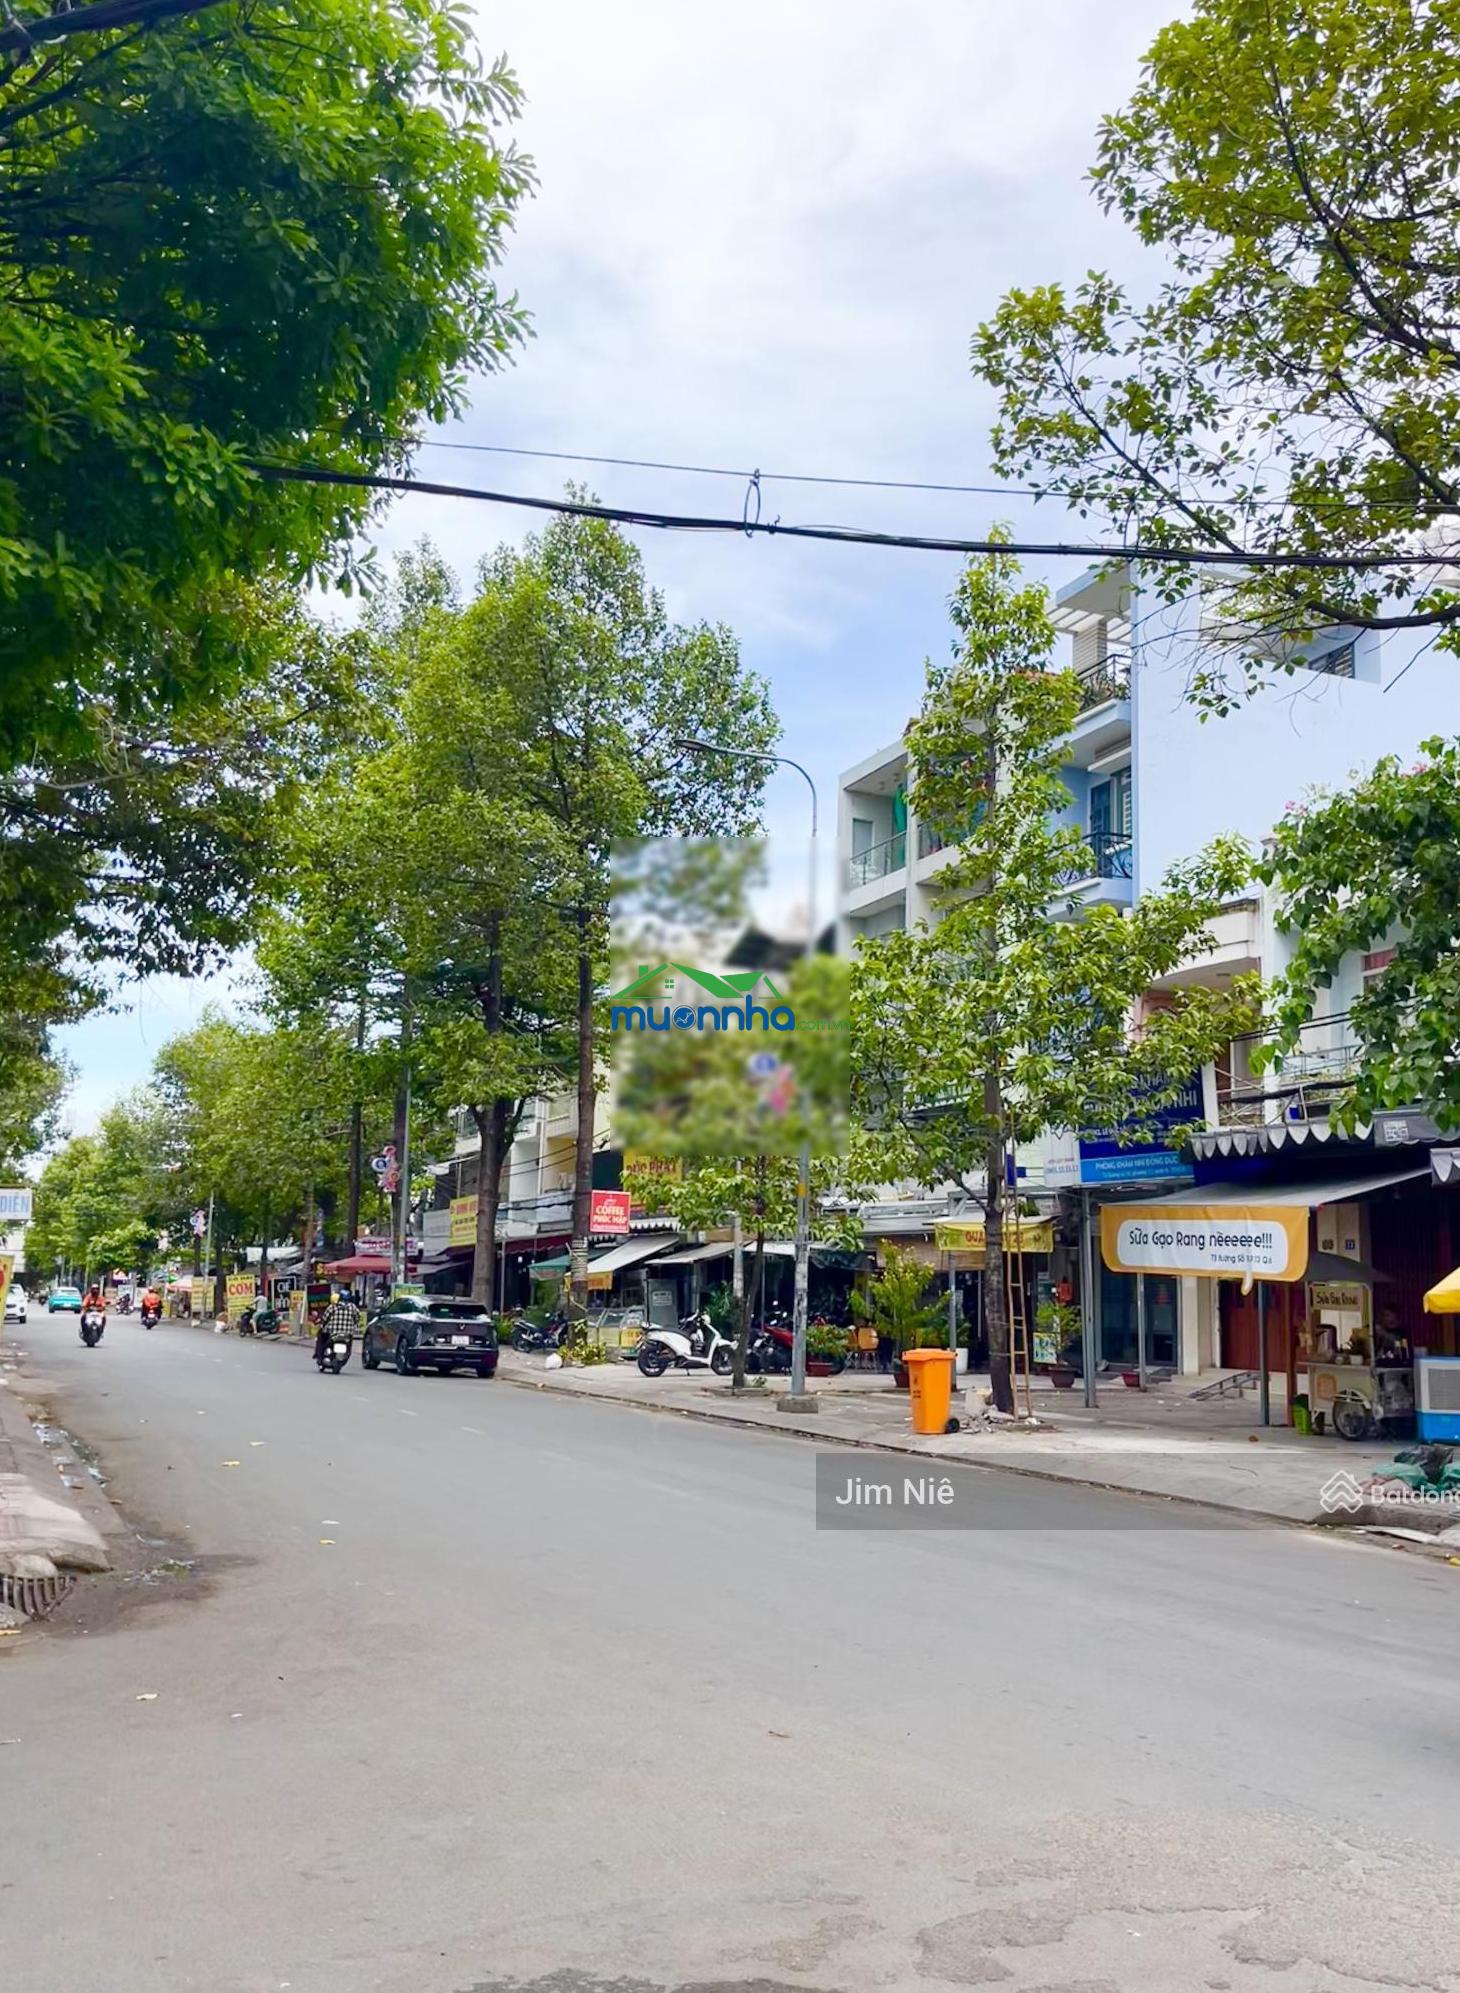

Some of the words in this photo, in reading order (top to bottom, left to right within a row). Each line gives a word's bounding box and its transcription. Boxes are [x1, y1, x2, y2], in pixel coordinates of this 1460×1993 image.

[595, 1205, 625, 1216] COFFEE
[1129, 1227, 1149, 1245] Sữa
[1152, 1231, 1173, 1249] Gạo
[1176, 1231, 1205, 1250] Rang
